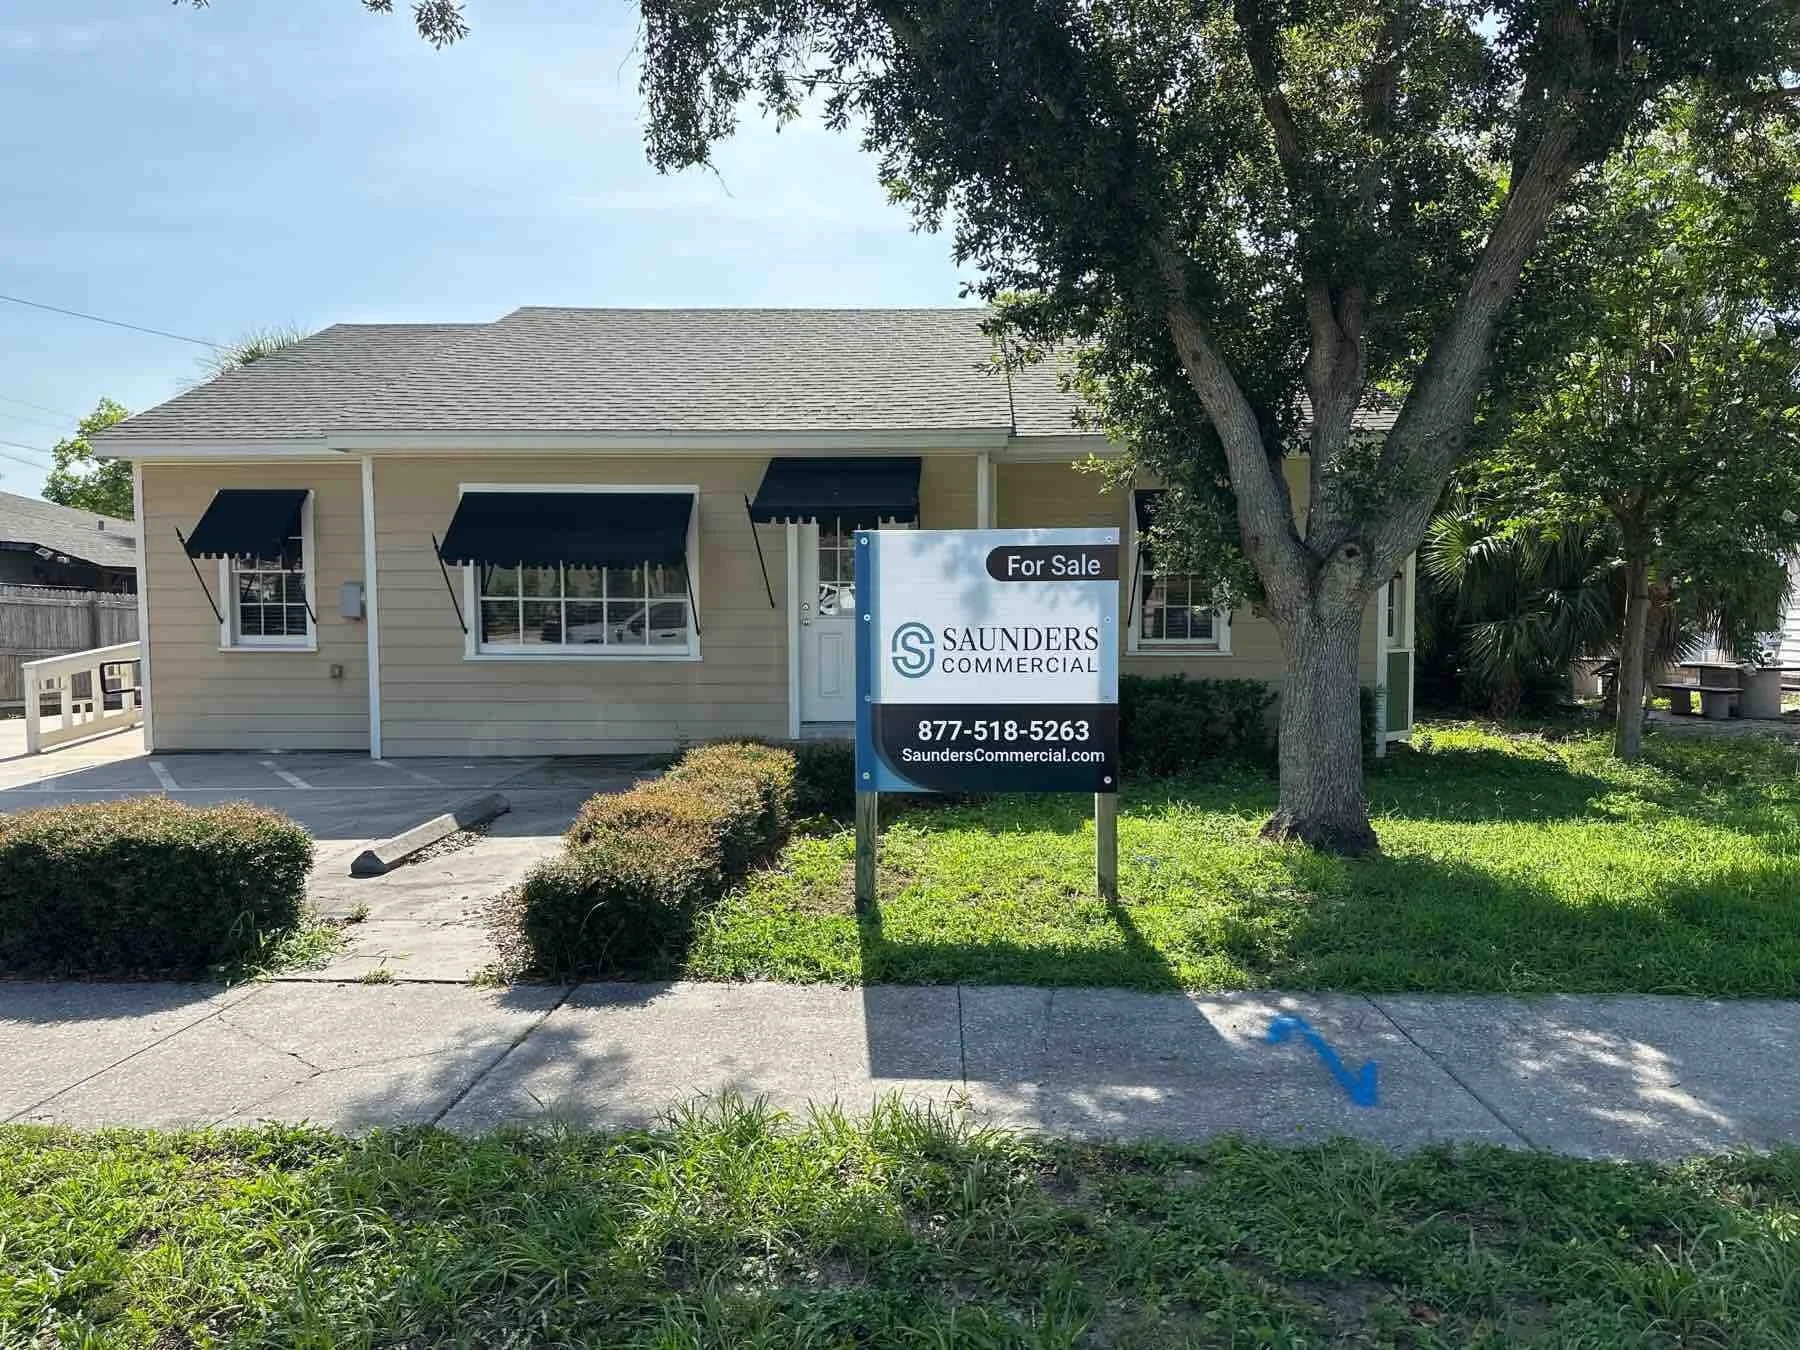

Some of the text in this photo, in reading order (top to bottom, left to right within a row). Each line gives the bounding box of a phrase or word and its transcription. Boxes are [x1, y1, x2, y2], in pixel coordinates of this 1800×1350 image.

[1007, 553, 1101, 576] For Sale
[943, 626, 1099, 651] SAUNDERS
[942, 657, 1099, 673] COMMERCIAL
[918, 720, 1090, 741] 877-518-5263
[902, 748, 1105, 763] SaundersCommercial.com
